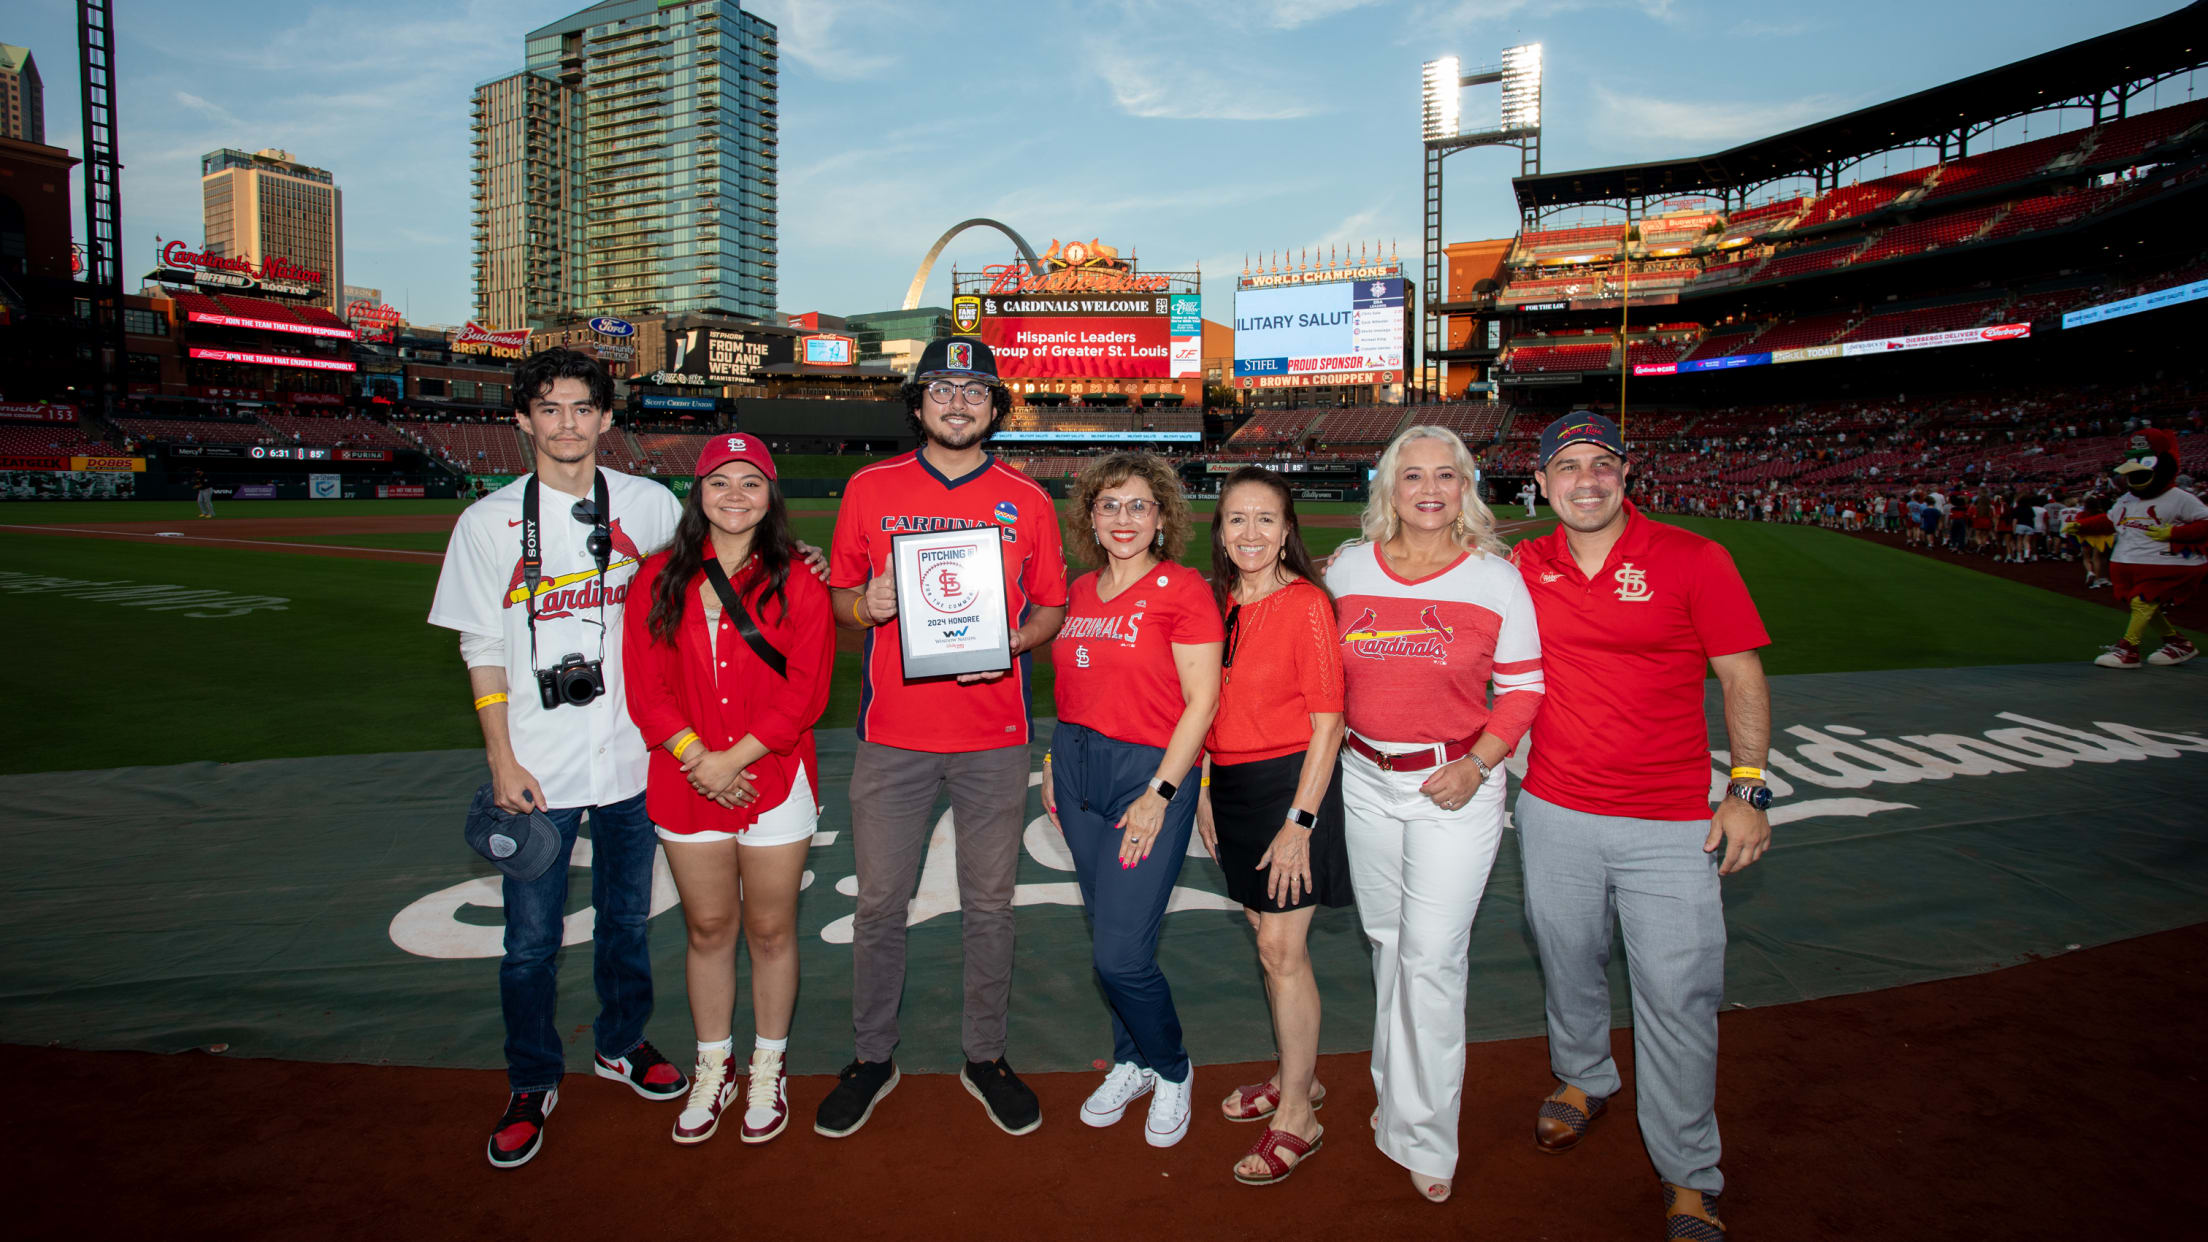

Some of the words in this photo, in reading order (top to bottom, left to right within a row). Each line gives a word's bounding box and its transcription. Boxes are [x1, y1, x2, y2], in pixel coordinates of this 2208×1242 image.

[163, 240, 254, 273] Cardinals
[252, 256, 320, 283] Nation
[982, 264, 1171, 294] Budweiser
[1252, 275, 1300, 286] WORLD
[1303, 267, 1387, 282] CHAMPIONS
[261, 282, 309, 296] ROOFTOP
[1004, 301, 1084, 312] CARDINALS
[1086, 301, 1149, 312] WELCOME
[225, 317, 240, 326] JOIN
[242, 319, 254, 327] THE
[254, 320, 272, 328] TEAM
[274, 322, 288, 330] THAT
[290, 324, 312, 334] ENJOYS
[312, 327, 354, 338] RESPONSIBLY.
[598, 319, 626, 334] Ford
[456, 327, 531, 344] Budweiser
[720, 332, 744, 340] PHORM
[1017, 331, 1076, 346] Hispanic
[1081, 331, 1136, 343] Leaders
[1906, 333, 1943, 344] DIERBERGS
[1944, 330, 1979, 340] DELIVERS
[1985, 326, 2026, 337] Dierbergs
[452, 342, 488, 356] BREW
[709, 339, 744, 352] FROM
[746, 344, 768, 356] THE
[1033, 345, 1048, 357] of
[1052, 346, 1106, 358] Greater
[1108, 346, 1126, 358] St.
[1131, 346, 1168, 358] Louis
[1808, 347, 1837, 358] TODAY!
[226, 352, 242, 360] JOIN
[290, 358, 312, 367] ENJOYS
[314, 361, 354, 371] RESPONSIBLY.
[709, 350, 732, 362] LOU
[735, 354, 760, 366] AND
[1244, 360, 1278, 372] STIFEL
[1288, 358, 1318, 372] PROUD
[1320, 356, 1364, 370] SPONSOR
[708, 362, 748, 376] WE'RE
[1260, 375, 1300, 387] BROWN
[1302, 377, 1310, 385] &
[1312, 373, 1375, 386] CROUPPEN
[1025, 384, 1034, 393] 10
[1056, 384, 1066, 393] 17
[1071, 384, 1083, 393] 20
[179, 448, 200, 457] Mercy
[270, 449, 290, 458] 6:31
[310, 450, 325, 458] 85°
[87, 458, 132, 468] DOBBS
[527, 518, 537, 558] SONY
[921, 549, 966, 562] PITCHING
[928, 618, 947, 627] 2024
[948, 616, 980, 625] HONOREE
[1352, 629, 1448, 660] Cardinals
